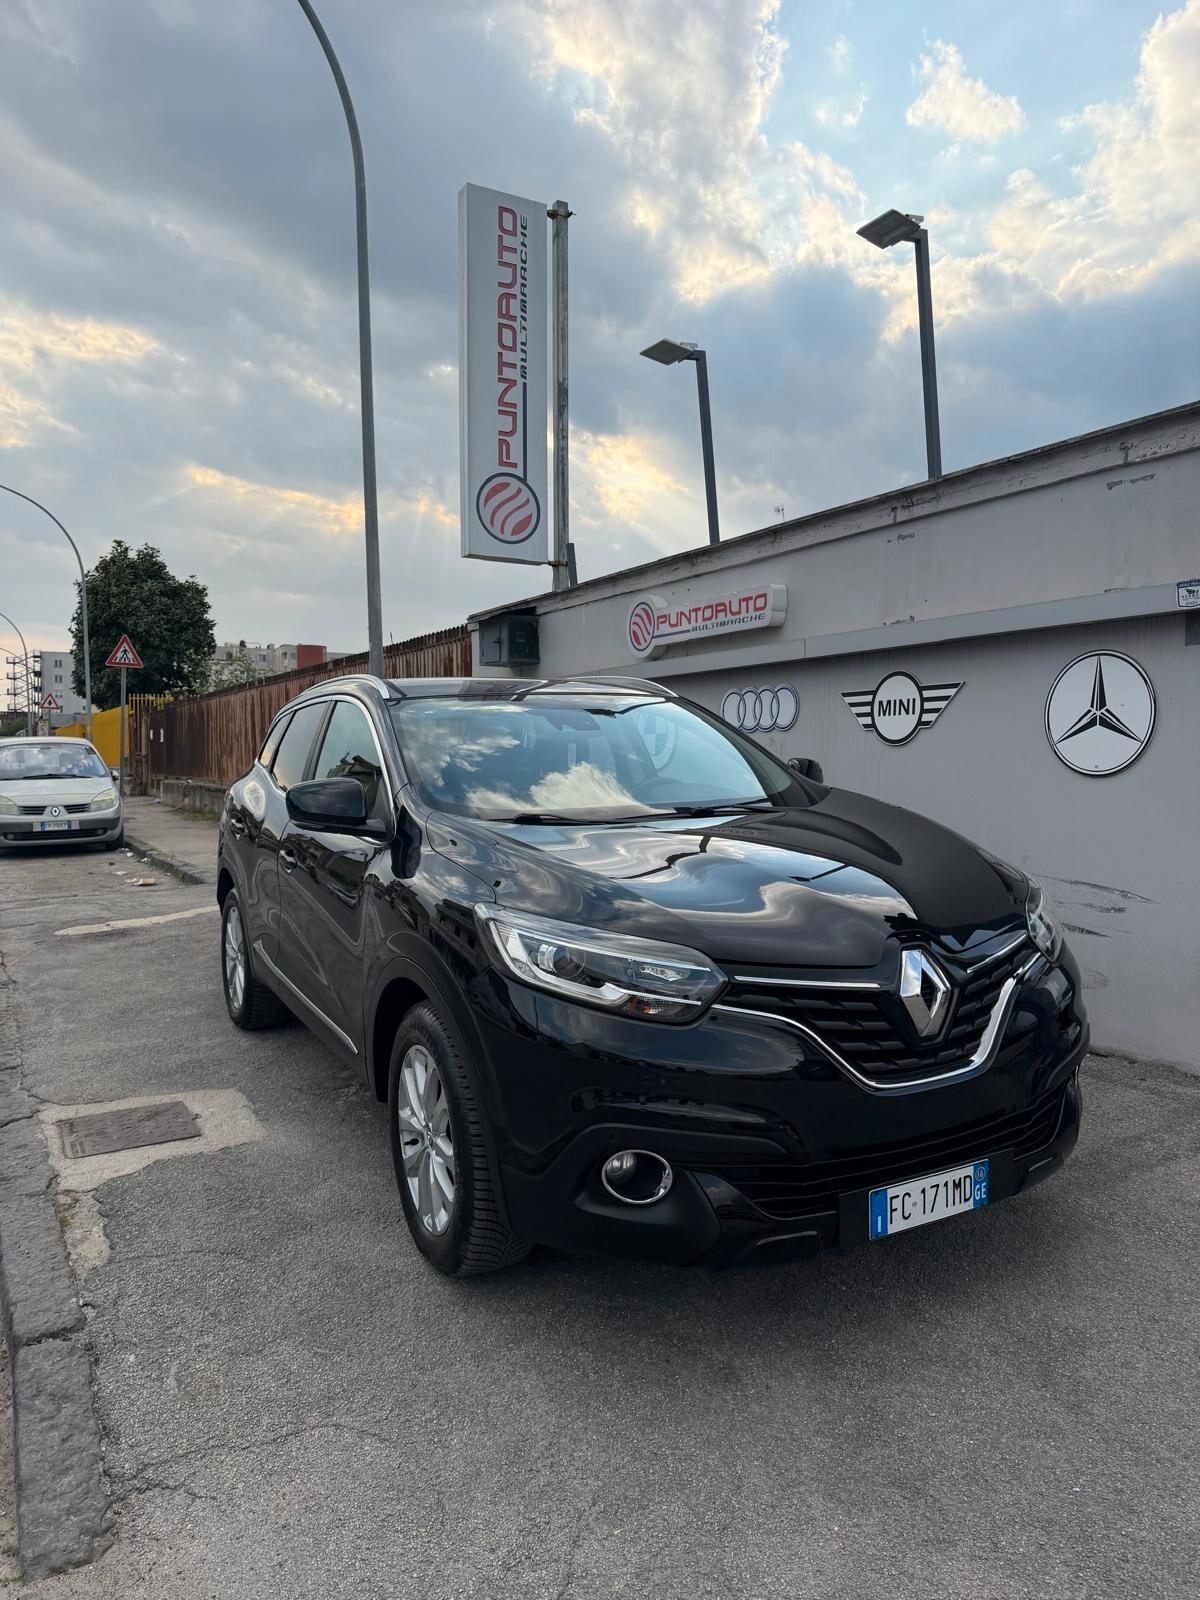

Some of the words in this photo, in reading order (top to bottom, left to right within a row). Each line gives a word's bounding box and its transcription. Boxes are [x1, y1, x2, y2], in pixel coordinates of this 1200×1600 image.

[519, 214, 528, 381] MULTIMARCHE
[498, 205, 518, 469] PUNTOAUTO
[656, 592, 768, 631] PUNTOAUTO
[691, 612, 767, 633] MULTIMARCHE
[878, 697, 916, 717] MINI
[974, 1182, 987, 1200] GE
